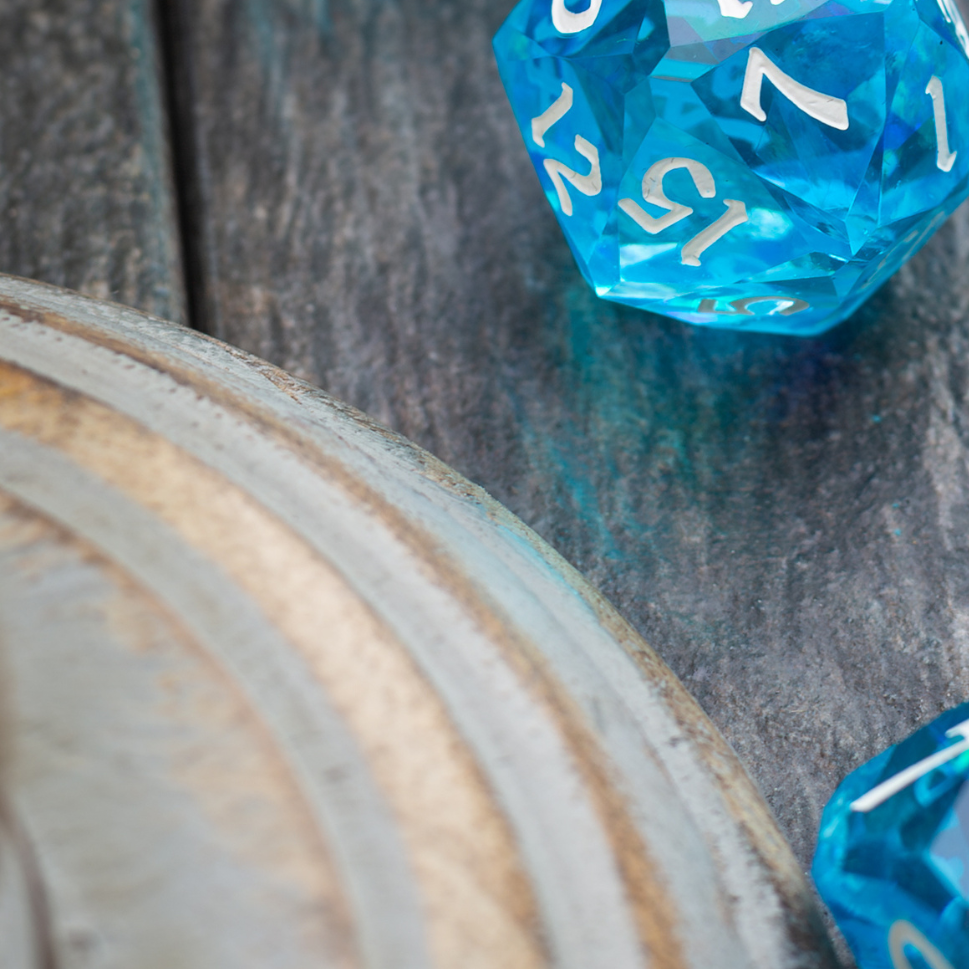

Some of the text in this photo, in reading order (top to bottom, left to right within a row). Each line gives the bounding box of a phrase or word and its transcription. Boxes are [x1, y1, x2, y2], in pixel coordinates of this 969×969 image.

[739, 46, 850, 131] 7
[925, 75, 957, 173] 1
[531, 82, 602, 218] 12
[618, 157, 749, 267] 15
